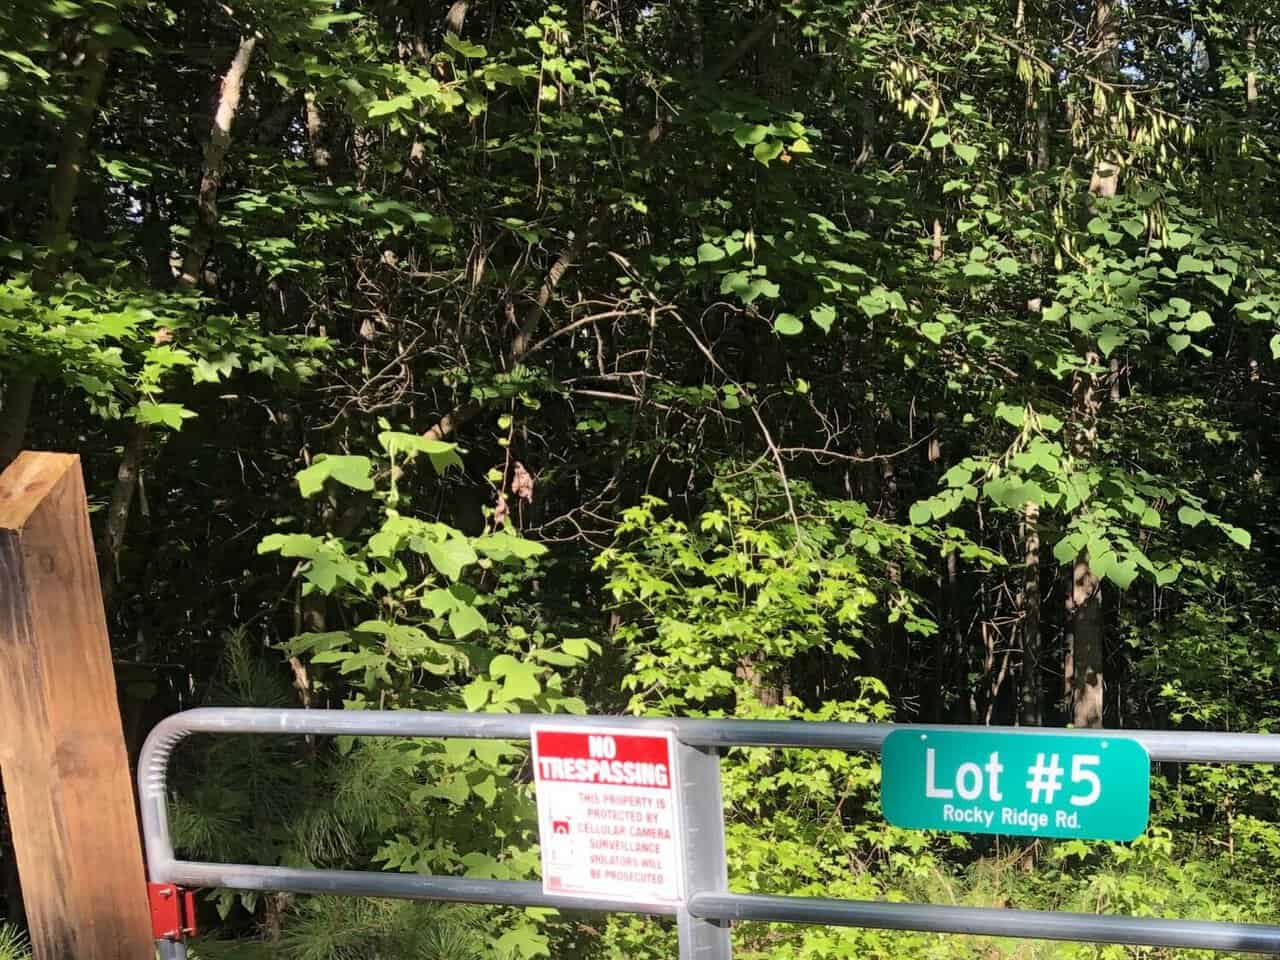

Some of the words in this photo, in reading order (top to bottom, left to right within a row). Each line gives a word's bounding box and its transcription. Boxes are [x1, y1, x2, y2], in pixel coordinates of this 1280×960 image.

[588, 735, 616, 758] NO
[539, 756, 668, 786] TRESPASSING
[926, 748, 1004, 802] Lot
[1025, 753, 1101, 807] #5
[579, 792, 600, 803] THIS
[603, 793, 652, 807] PROPERTY
[656, 798, 666, 809] IS
[587, 808, 642, 822] PROTECTED
[646, 814, 658, 824] BY
[943, 804, 995, 828] Rocky
[1001, 807, 1048, 831] Ridge
[1055, 810, 1081, 829] Rd.
[577, 823, 625, 835] CELLULAR
[630, 826, 671, 840] CAMERA
[590, 838, 661, 853] SURVEILLANCE
[590, 855, 638, 867] VIOLATORS
[641, 859, 662, 869] WILL
[590, 870, 601, 879] BE
[605, 870, 664, 884] PROSECUTED
